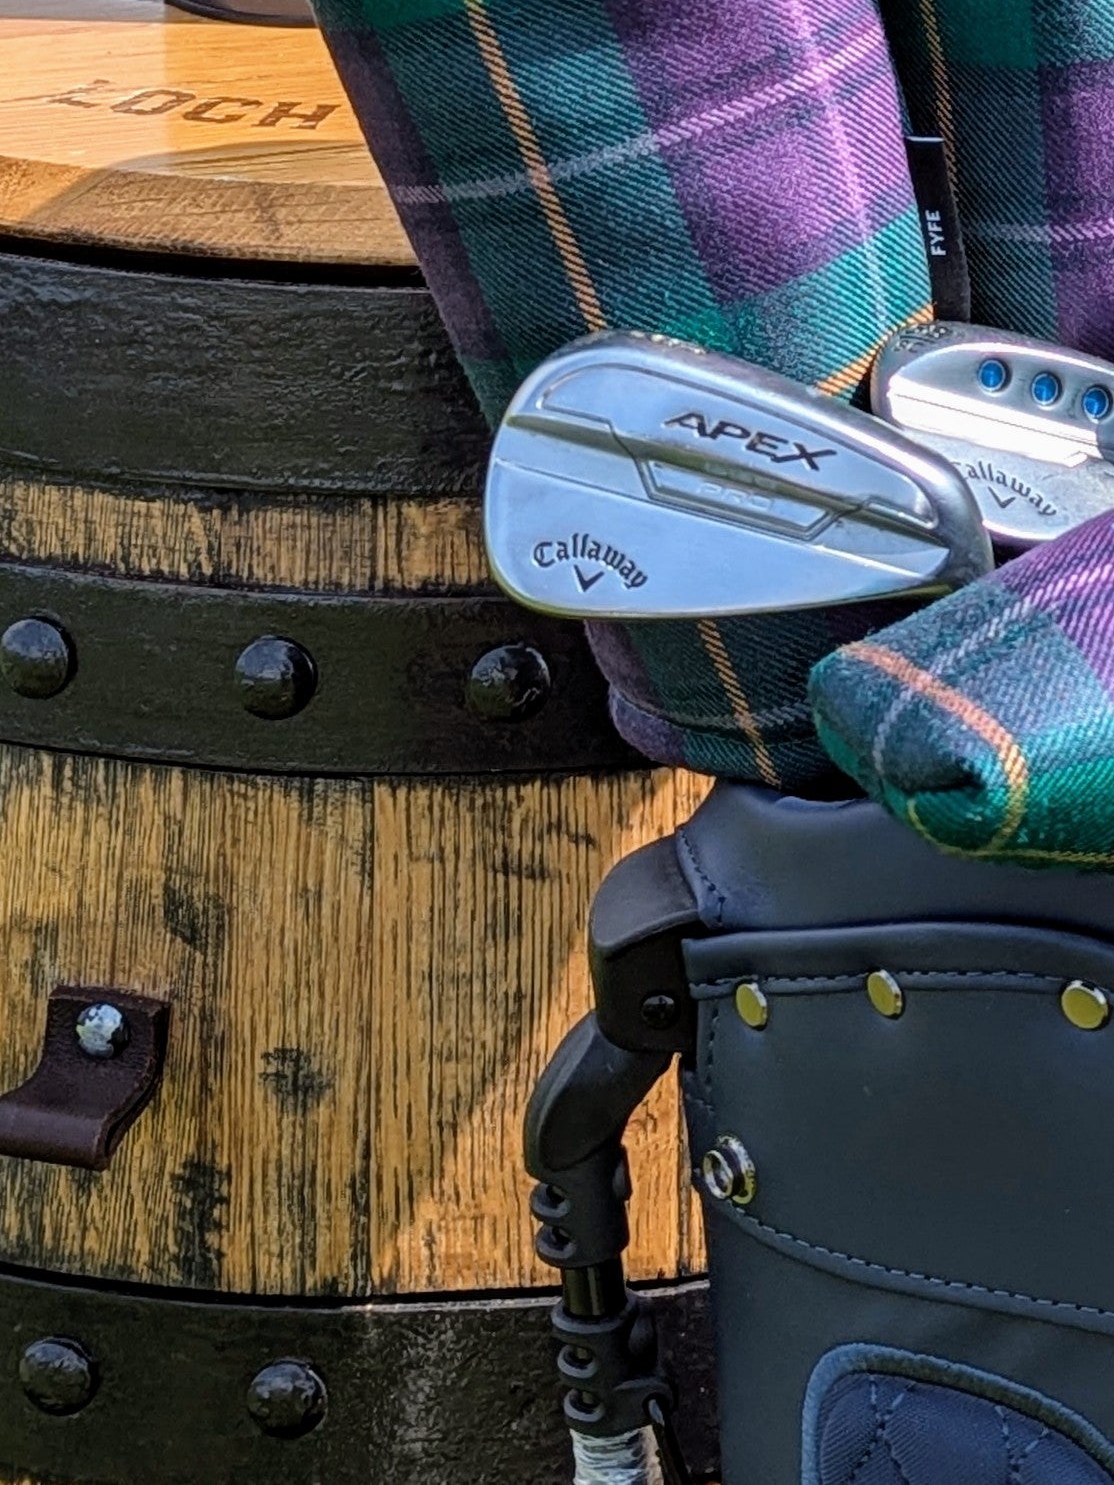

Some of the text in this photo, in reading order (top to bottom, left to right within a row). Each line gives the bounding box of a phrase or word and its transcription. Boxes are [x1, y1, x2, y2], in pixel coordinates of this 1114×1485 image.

[48, 78, 341, 130] LOCH
[925, 210, 947, 257] FYFE
[662, 412, 838, 472] APEX
[951, 460, 1057, 517] allaway
[533, 532, 648, 590] Callaway
